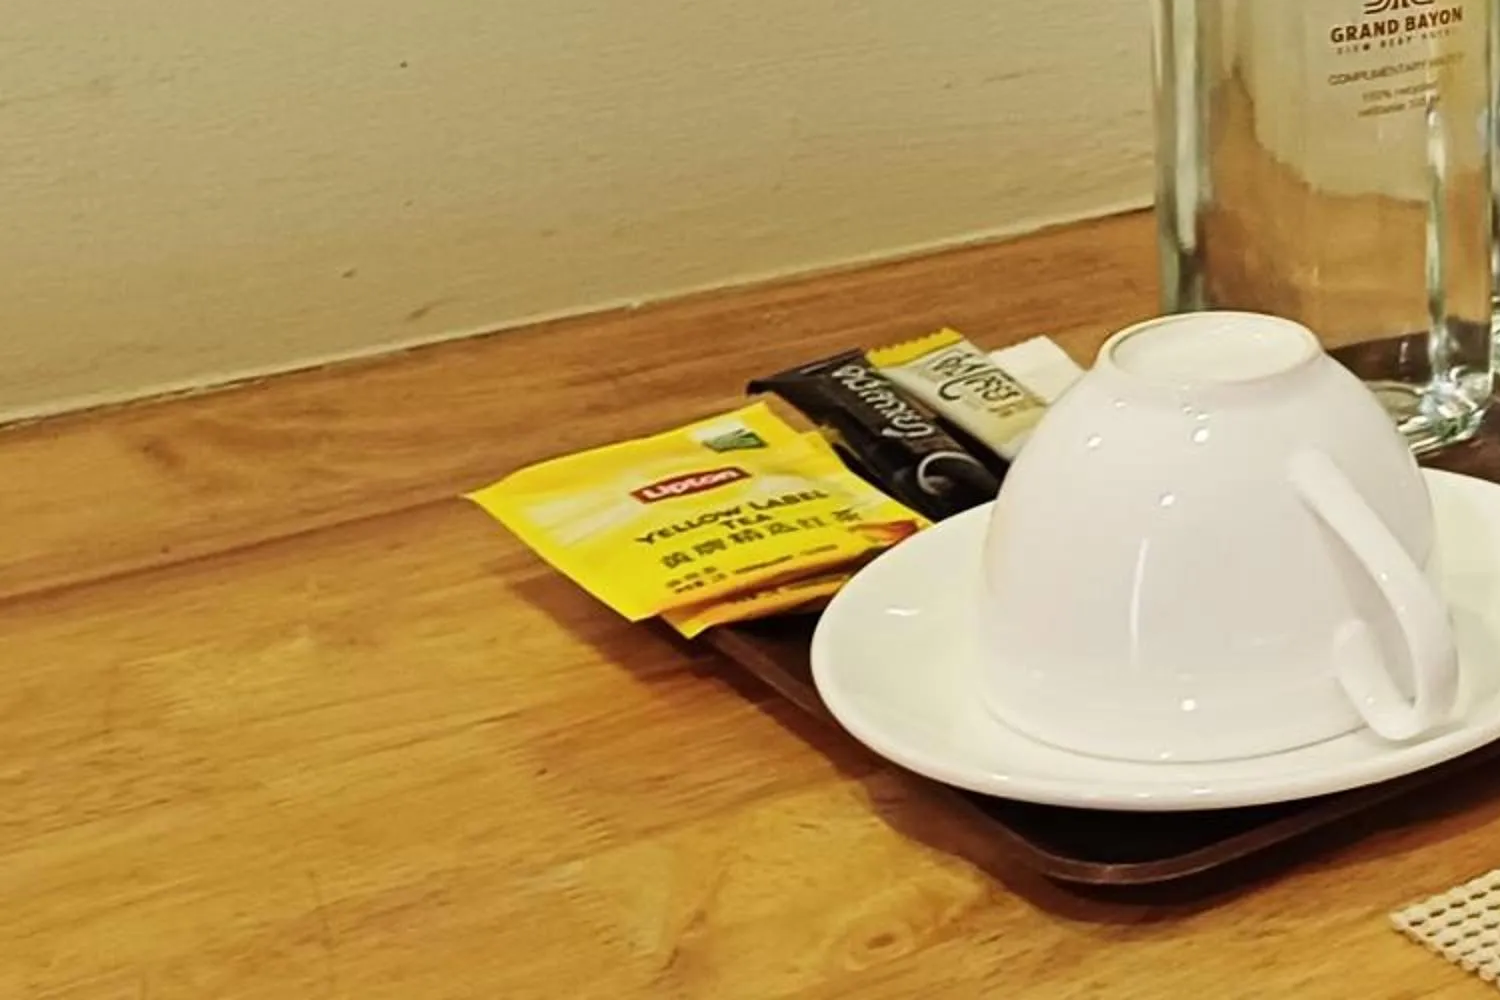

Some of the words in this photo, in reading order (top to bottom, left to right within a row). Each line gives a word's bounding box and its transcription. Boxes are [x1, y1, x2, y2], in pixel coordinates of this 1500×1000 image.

[1330, 19, 1400, 43] GRAND
[1404, 6, 1463, 32] BAYON
[634, 505, 742, 544] YELLOW
[747, 489, 829, 511] LABEL
[719, 513, 773, 530] TEA
